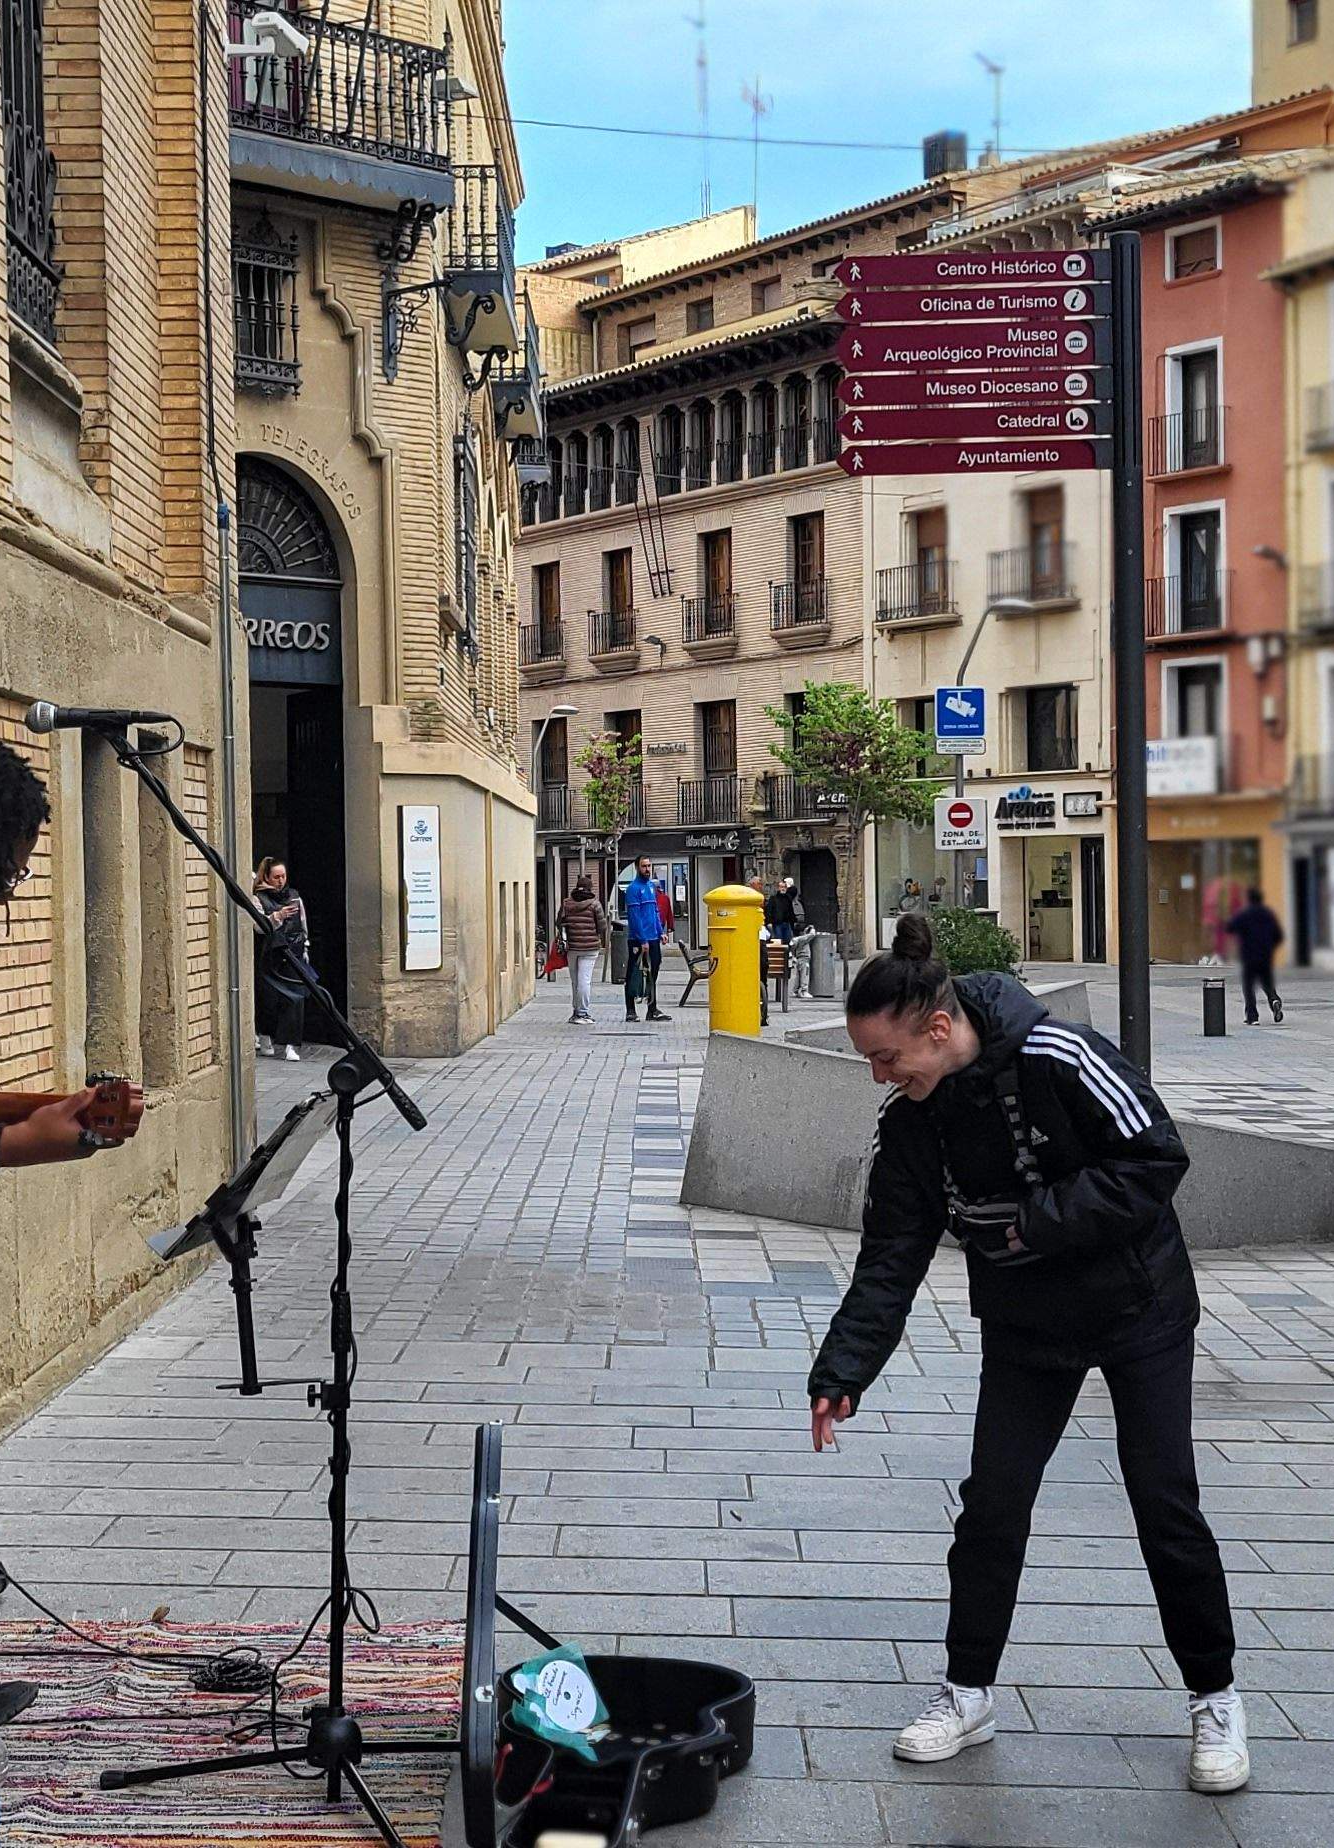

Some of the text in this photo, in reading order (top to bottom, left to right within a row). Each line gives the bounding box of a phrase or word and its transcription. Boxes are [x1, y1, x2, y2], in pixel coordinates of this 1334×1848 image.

[937, 258, 1057, 276] Centro Histórico
[920, 294, 1058, 312] Oficina de Turismo
[1007, 328, 1058, 342] Museo
[883, 344, 1058, 364] Arqueológico Provincial
[926, 379, 1059, 396] Museo Diocesano
[997, 413, 1060, 429] Catedral
[957, 448, 1060, 465] Ayuntamiento
[260, 423, 362, 520] TELEGRAFOS
[994, 797, 1056, 819] Arenas
[941, 838, 981, 846] ESTCIA
